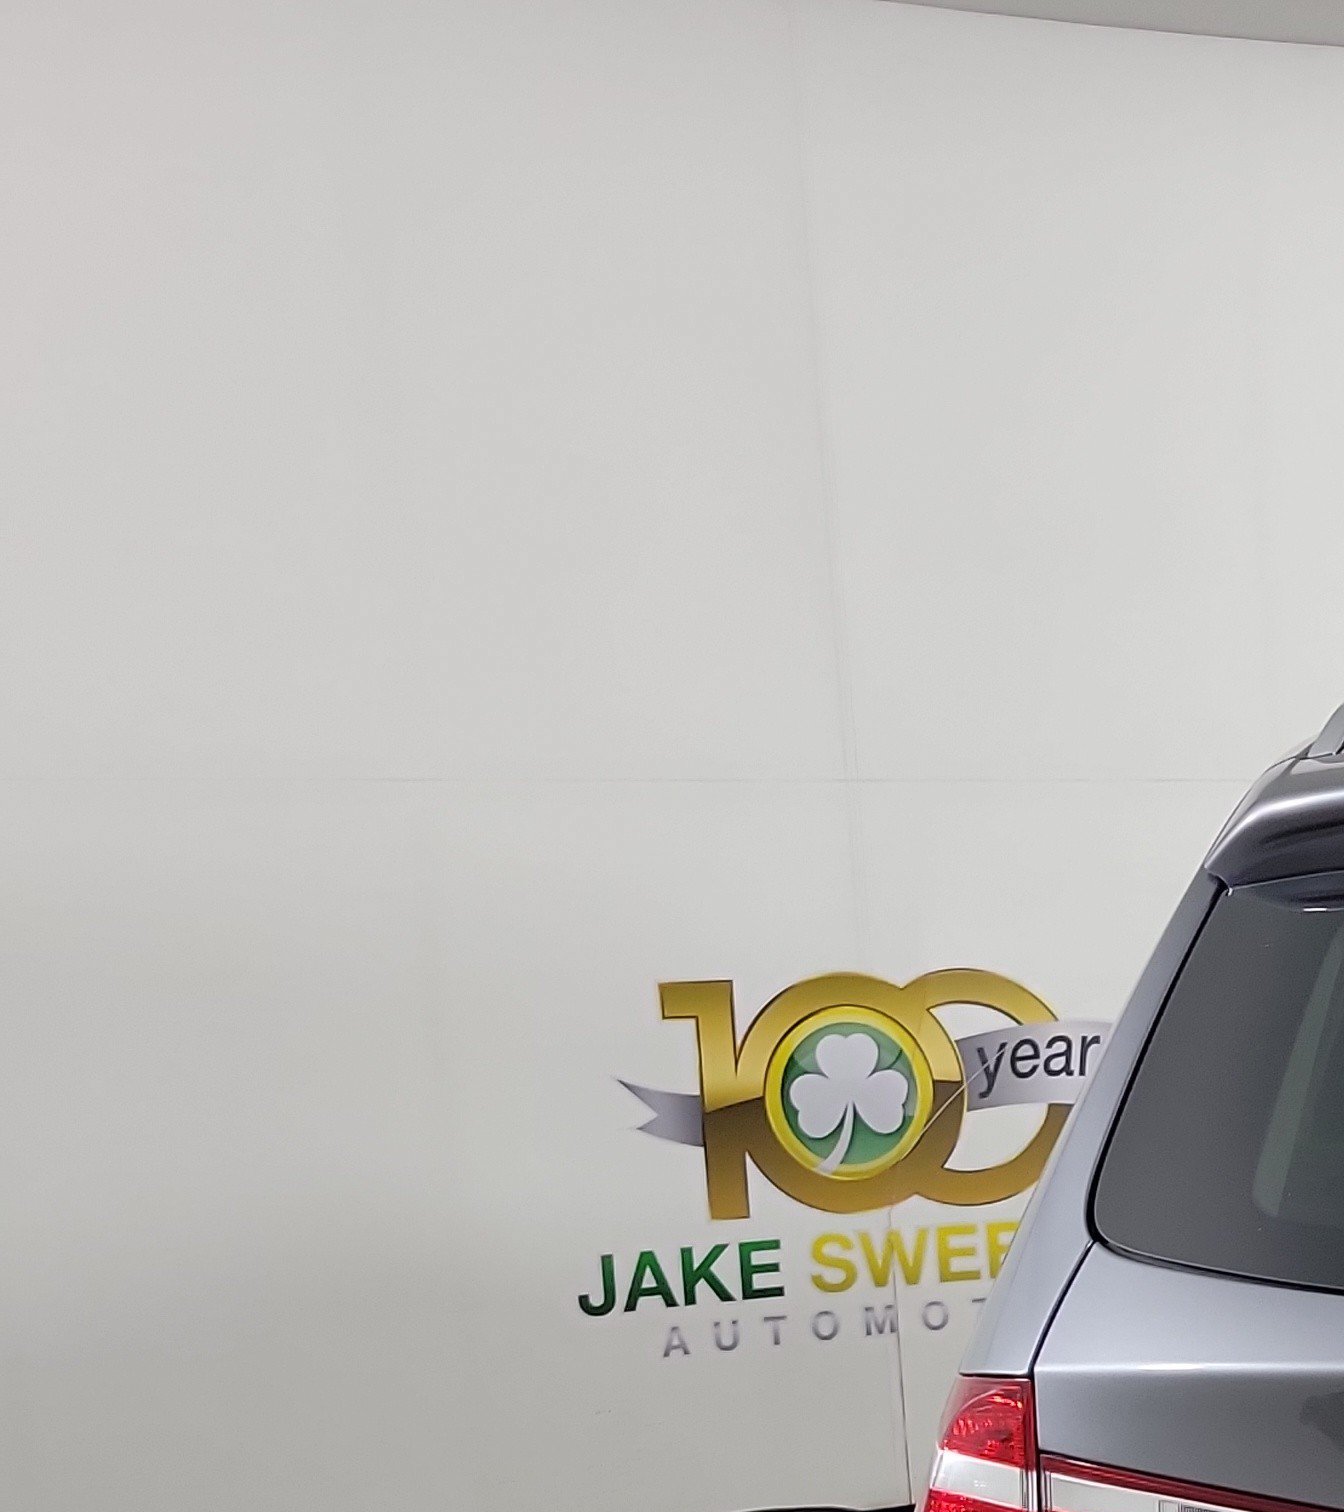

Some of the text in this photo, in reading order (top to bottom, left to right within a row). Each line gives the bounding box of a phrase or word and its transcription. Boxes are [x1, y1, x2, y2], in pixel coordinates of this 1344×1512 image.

[658, 968, 1076, 1221] 100
[578, 1238, 786, 1317] JAKE
[661, 1298, 986, 1359] AUTOMO
